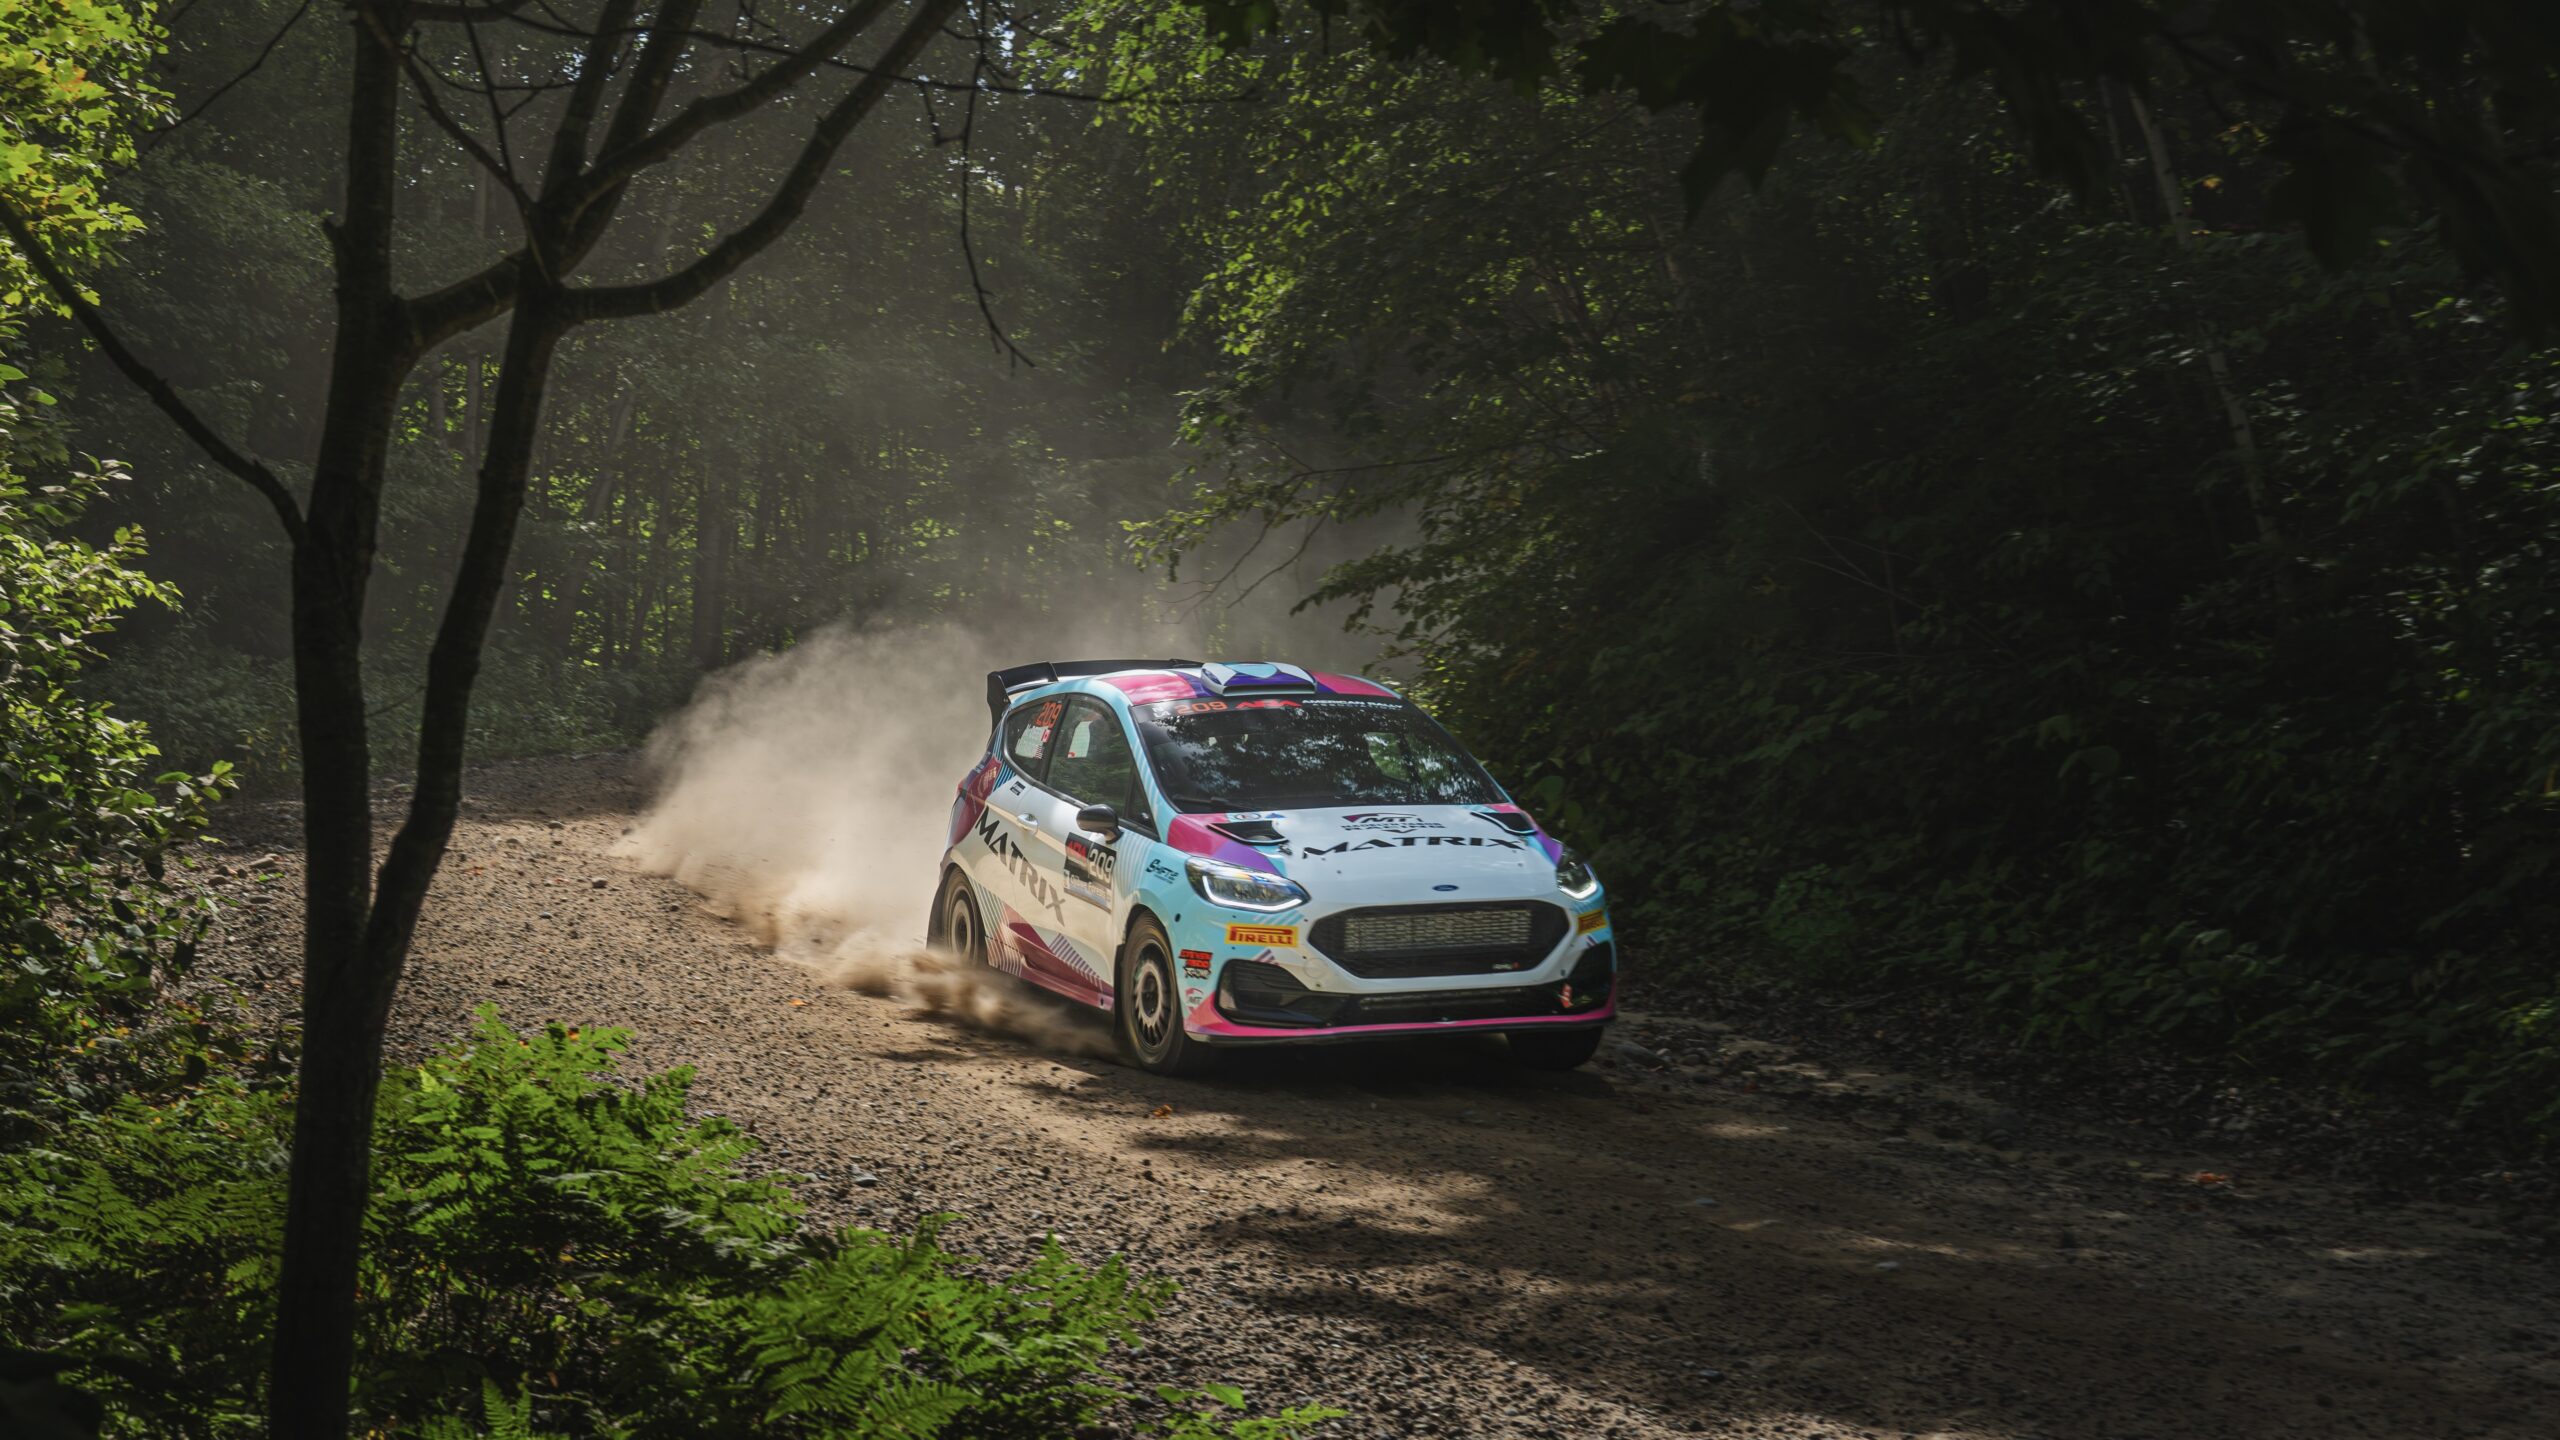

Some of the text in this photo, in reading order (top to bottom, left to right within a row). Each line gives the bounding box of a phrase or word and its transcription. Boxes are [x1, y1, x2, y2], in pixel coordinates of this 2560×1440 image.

[1036, 702, 1063, 729] 209
[1175, 700, 1228, 716] 209
[1303, 836, 1525, 859] MATRIX
[975, 806, 1066, 927] MATRIX
[1088, 848, 1115, 884] 209
[1229, 926, 1293, 945] PIRELLI
